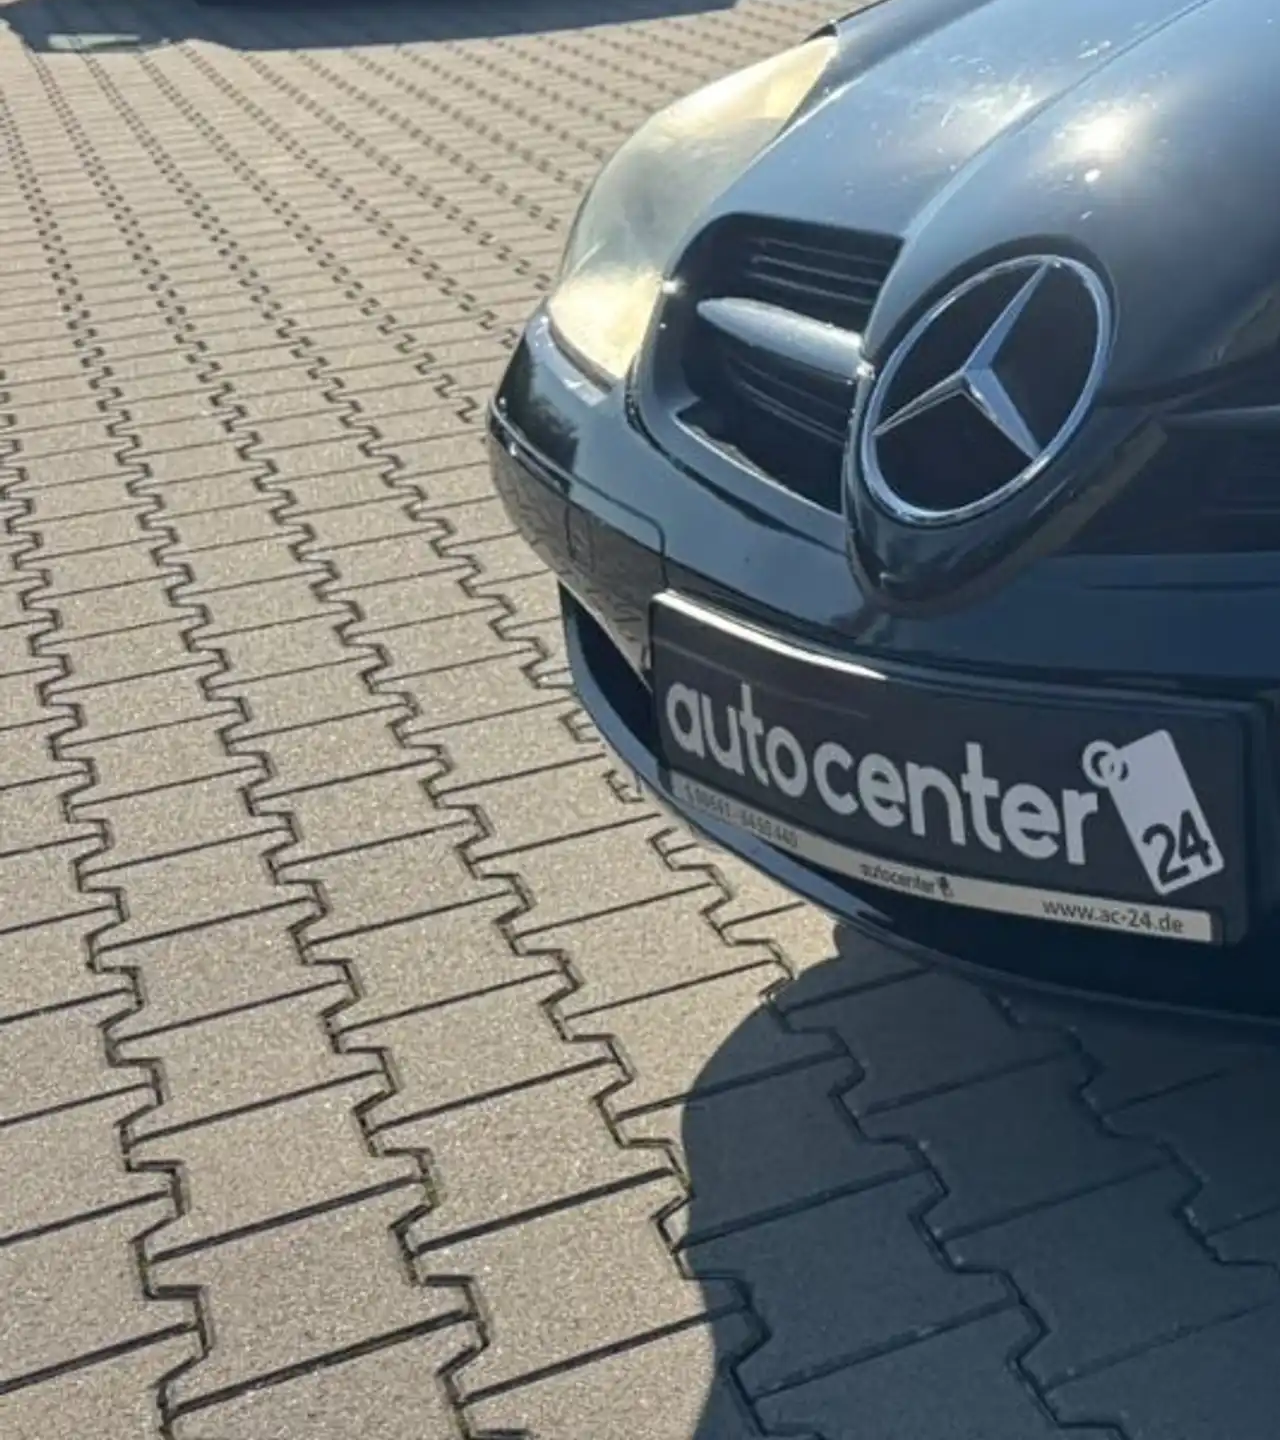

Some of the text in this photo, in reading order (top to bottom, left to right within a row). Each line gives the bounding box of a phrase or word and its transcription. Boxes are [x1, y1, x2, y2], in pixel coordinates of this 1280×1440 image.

[665, 682, 1099, 866] autocenter
[1141, 808, 1213, 887] 24
[1040, 899, 1185, 934] www.ac-24.de
